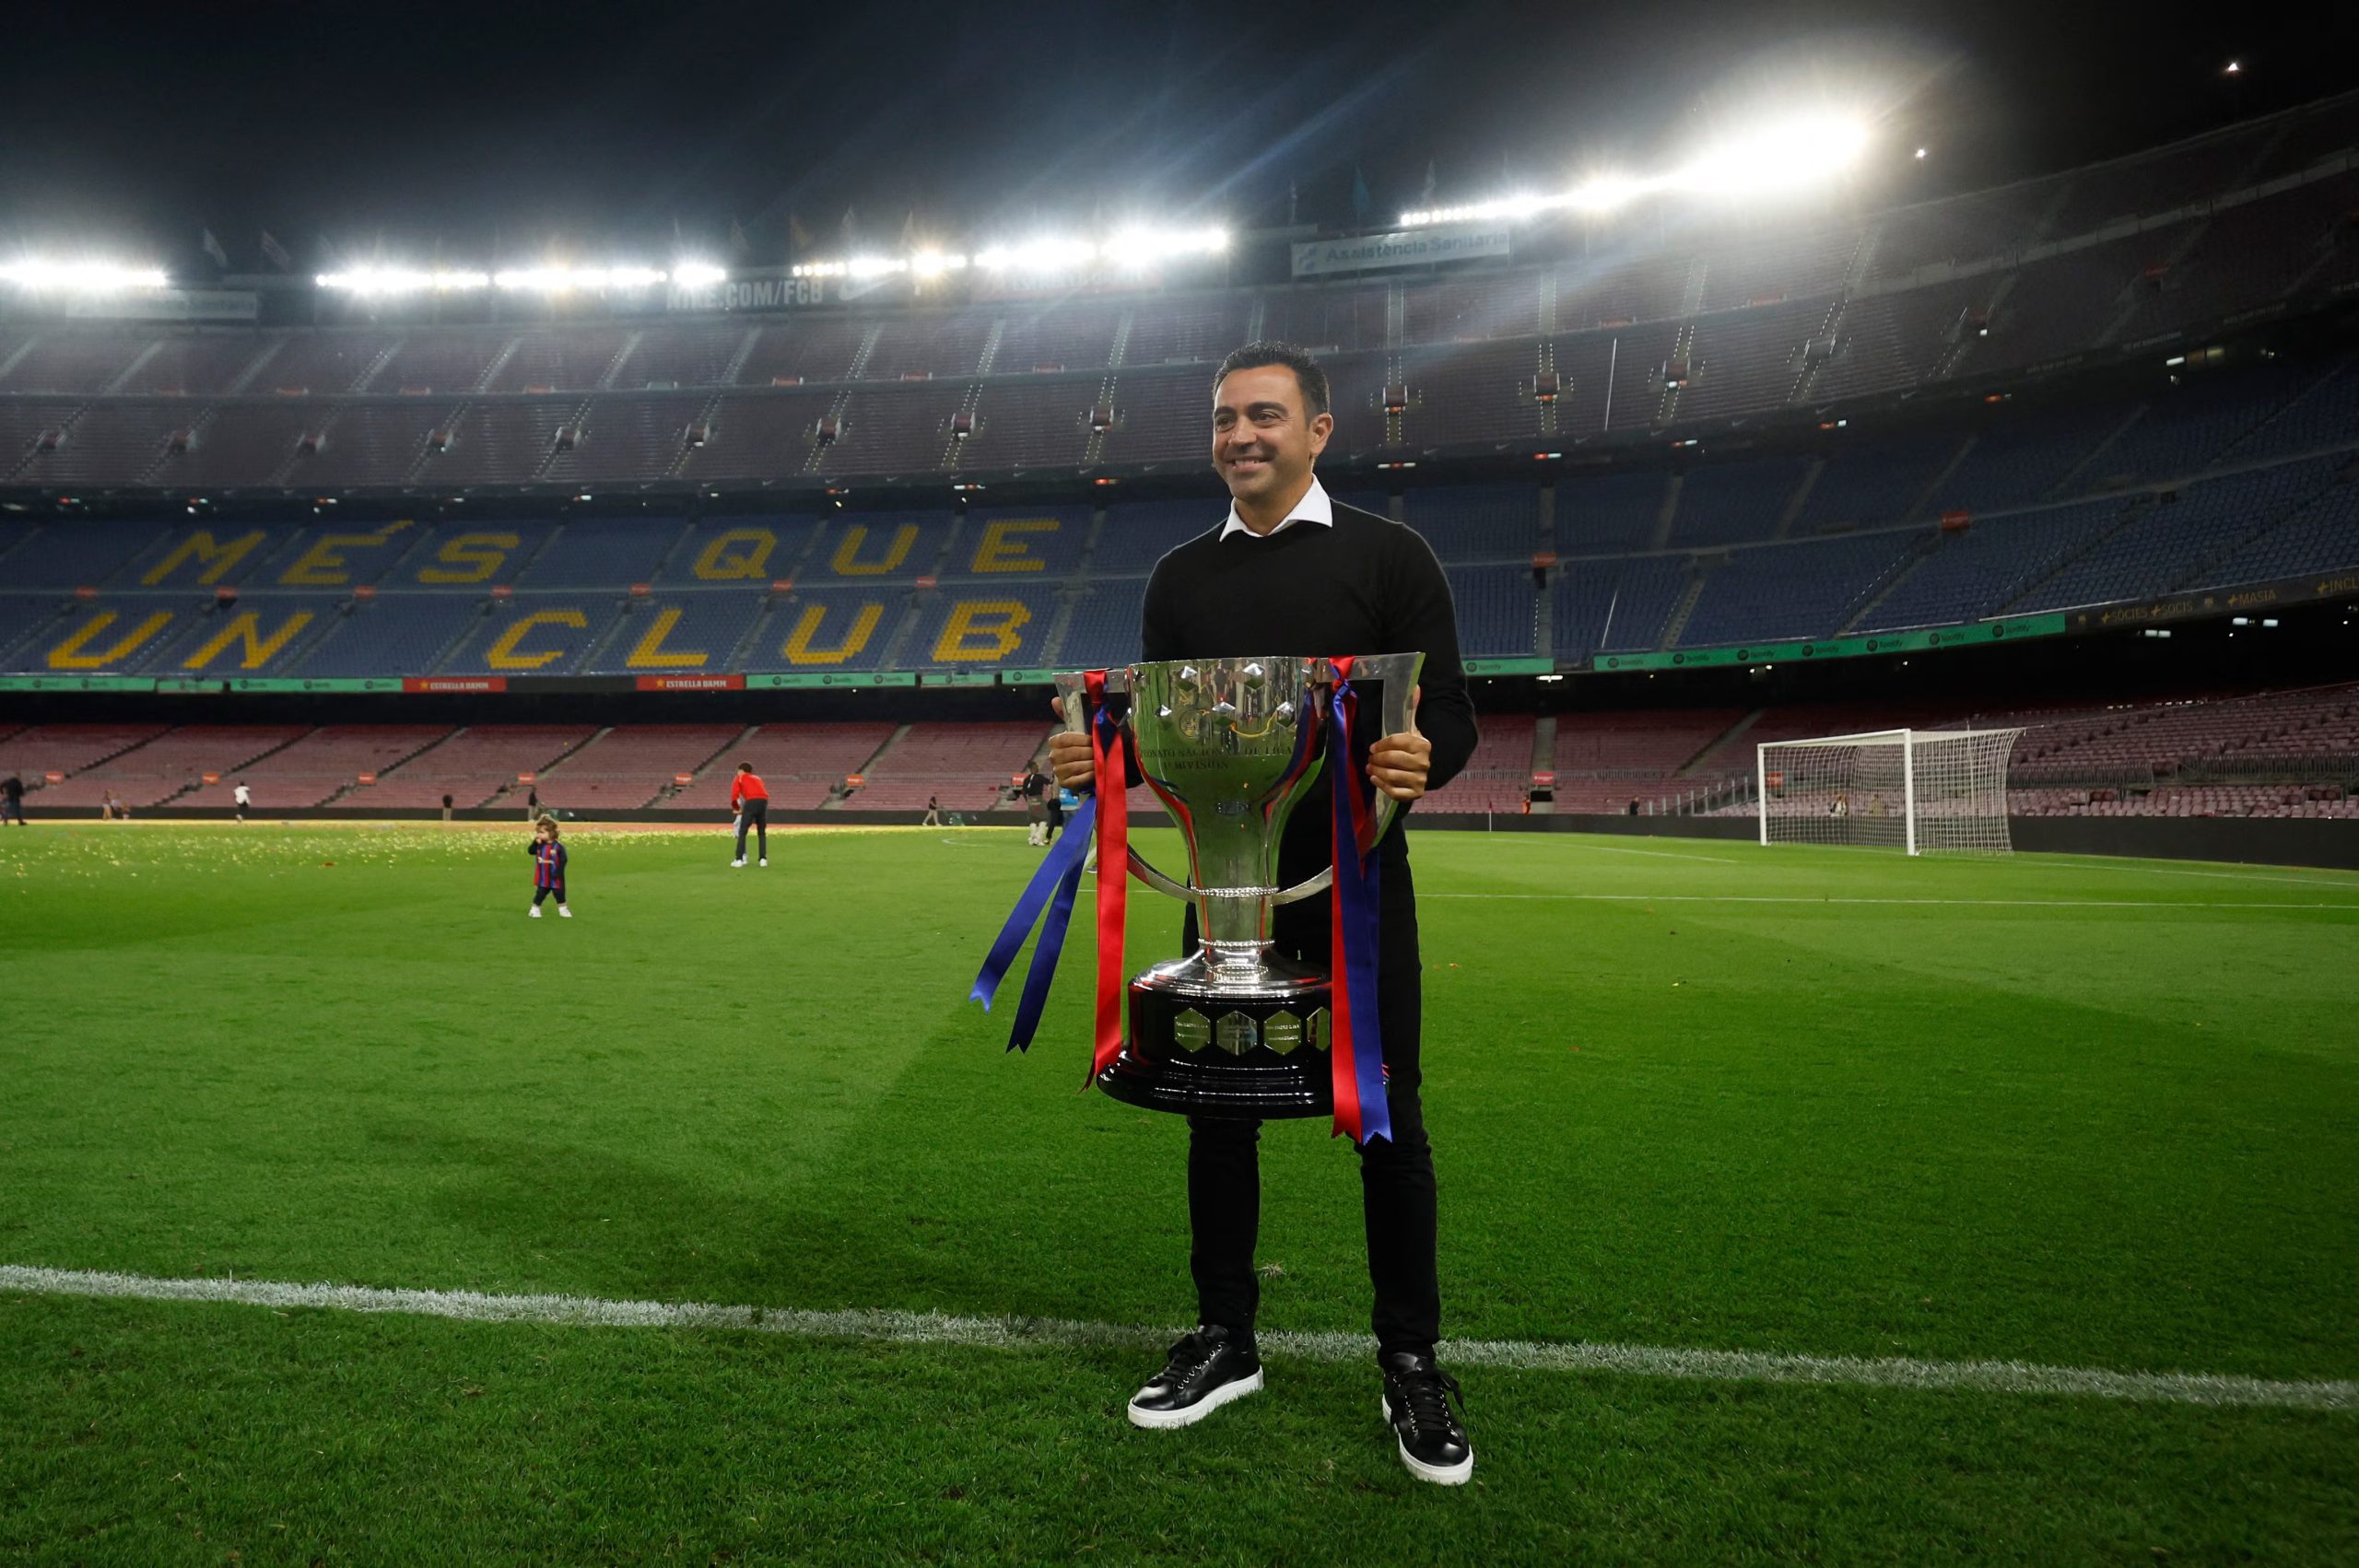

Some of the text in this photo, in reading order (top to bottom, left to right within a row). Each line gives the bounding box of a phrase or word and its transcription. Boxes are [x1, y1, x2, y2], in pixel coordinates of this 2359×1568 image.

[693, 519, 1061, 579] QUE
[2330, 575, 2359, 593] INCL
[48, 601, 1032, 669] UN CLUB
[665, 680, 701, 688] ESTRELLA
